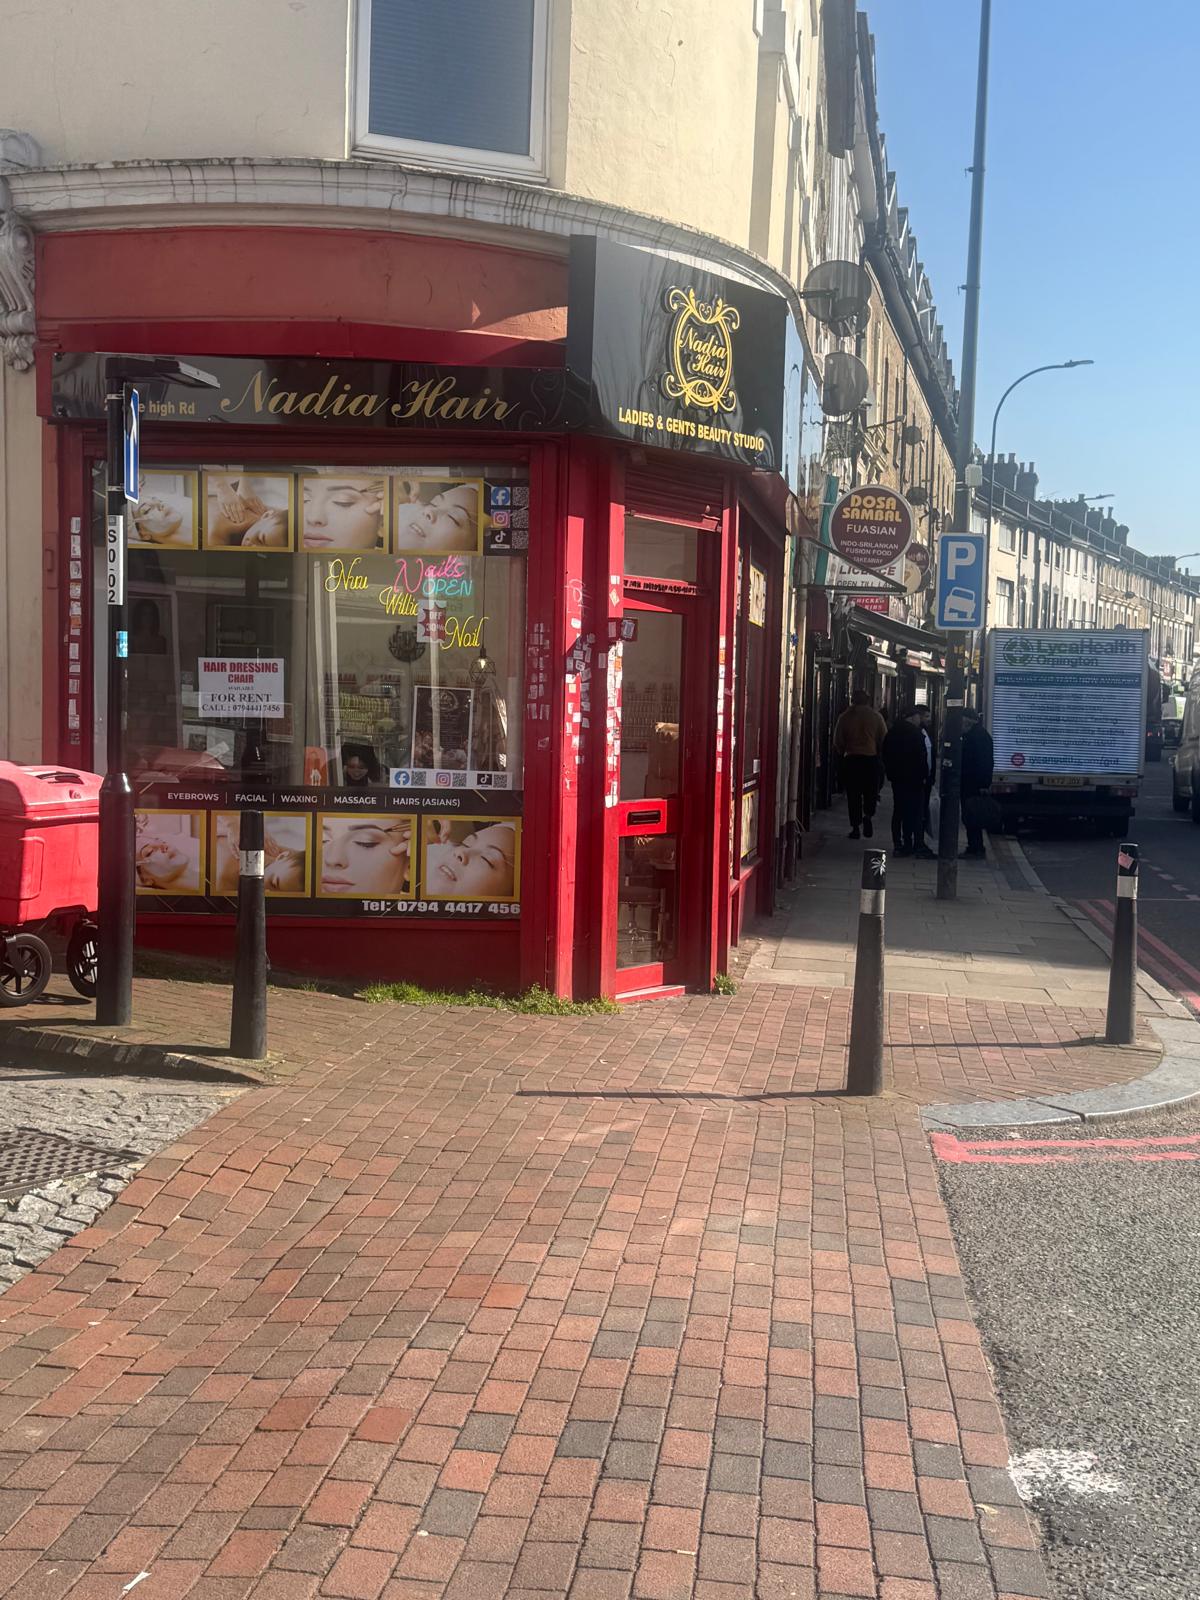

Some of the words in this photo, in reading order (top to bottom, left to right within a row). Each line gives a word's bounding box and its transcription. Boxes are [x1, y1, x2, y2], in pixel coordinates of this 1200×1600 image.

[679, 328, 728, 359] Nadia
[692, 354, 727, 378] Hair
[219, 369, 391, 417] Nadia
[391, 376, 520, 421] Hair
[149, 400, 175, 417] high
[179, 401, 195, 415] Rd
[618, 407, 654, 428] LADIES
[656, 415, 664, 430] &
[666, 418, 696, 437] GENTS
[697, 424, 731, 445] BEAUTY
[733, 432, 765, 452] STUDIO
[850, 494, 896, 510] DOSA
[841, 507, 901, 522] SAMBAL
[846, 524, 897, 536] FUASIAN
[947, 541, 977, 580] P
[392, 555, 465, 593] Nails
[421, 578, 473, 597] OPEN
[440, 615, 489, 650] Nail
[203, 662, 227, 672] HAIR
[229, 662, 278, 673] DRESSING
[228, 674, 254, 684] CHAIR
[211, 693, 235, 703] FOR
[240, 693, 272, 703] RENT
[167, 792, 219, 801] EYEBROWS
[235, 794, 267, 802] FACIAL
[281, 795, 318, 803] WAXING
[333, 796, 377, 805] MASSAGE
[392, 798, 420, 806] HAIRS
[422, 798, 461, 807] (ASIANS)
[362, 900, 392, 912] Tel:
[397, 901, 439, 913] 0794
[444, 902, 483, 914] 4417
[488, 903, 521, 914] 456
